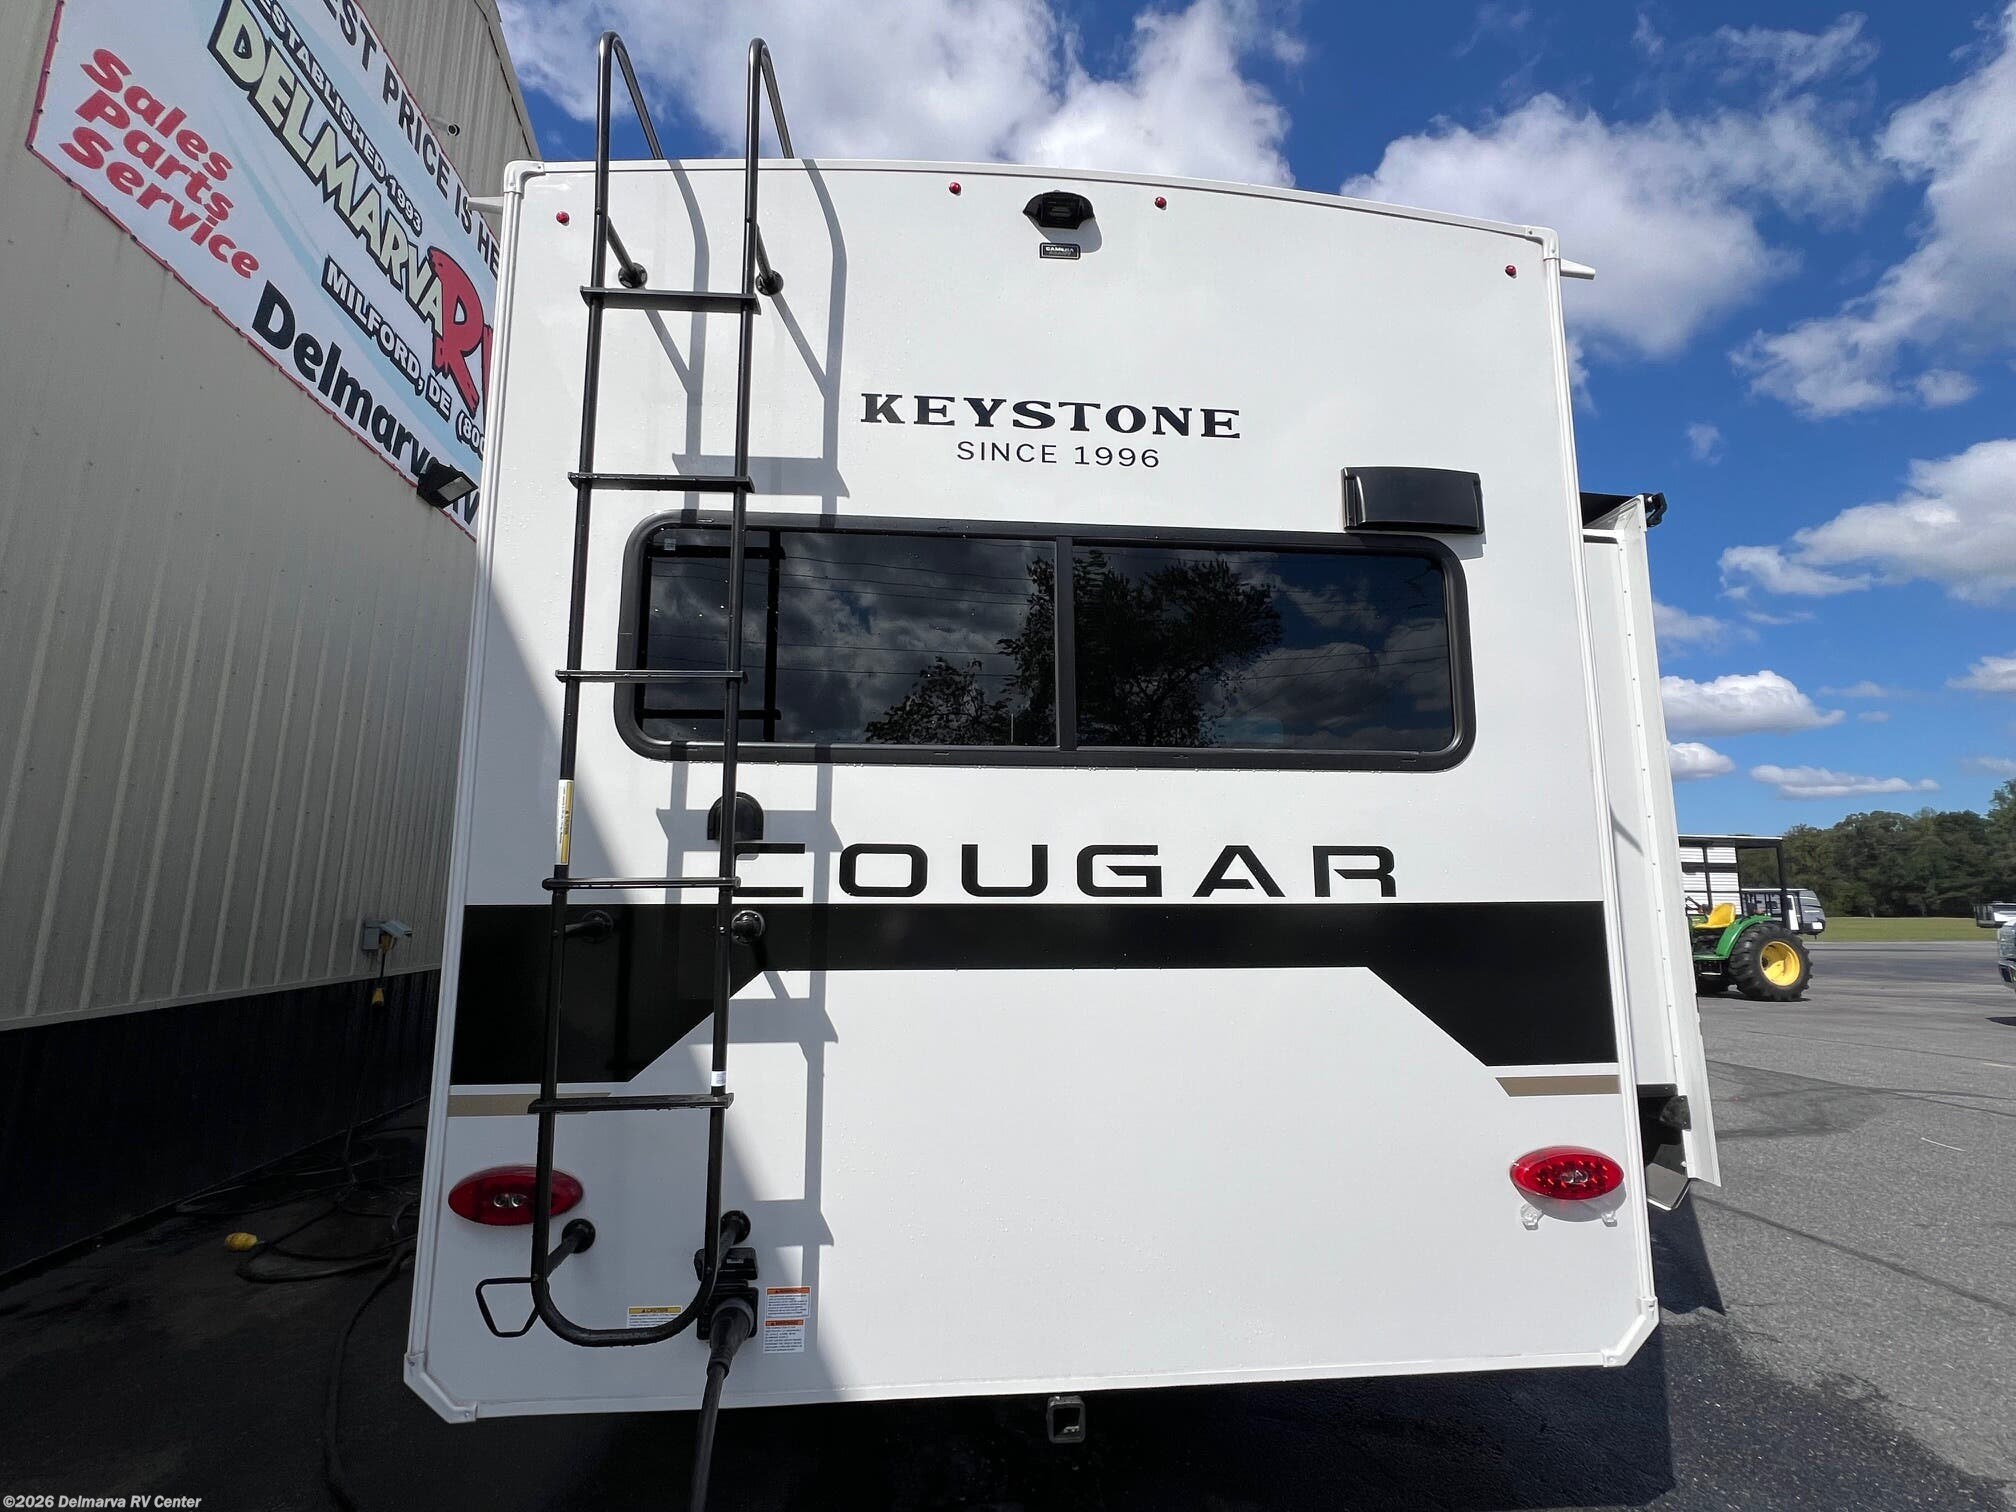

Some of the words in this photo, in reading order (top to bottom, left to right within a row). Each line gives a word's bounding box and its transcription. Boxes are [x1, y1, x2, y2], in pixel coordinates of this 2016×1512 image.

[75, 90, 234, 221] Parts
[80, 48, 233, 182] Sales
[208, 0, 444, 341] DELMARVA
[382, 63, 450, 200] PRICE
[455, 184, 472, 234] IS
[59, 126, 259, 279] Service
[387, 175, 422, 236] 1993
[322, 256, 425, 395] MILFORD,
[425, 374, 452, 421] DE
[861, 393, 1240, 439] KEYSTONE
[957, 441, 1058, 465] SINCE
[1075, 445, 1160, 468] 1996
